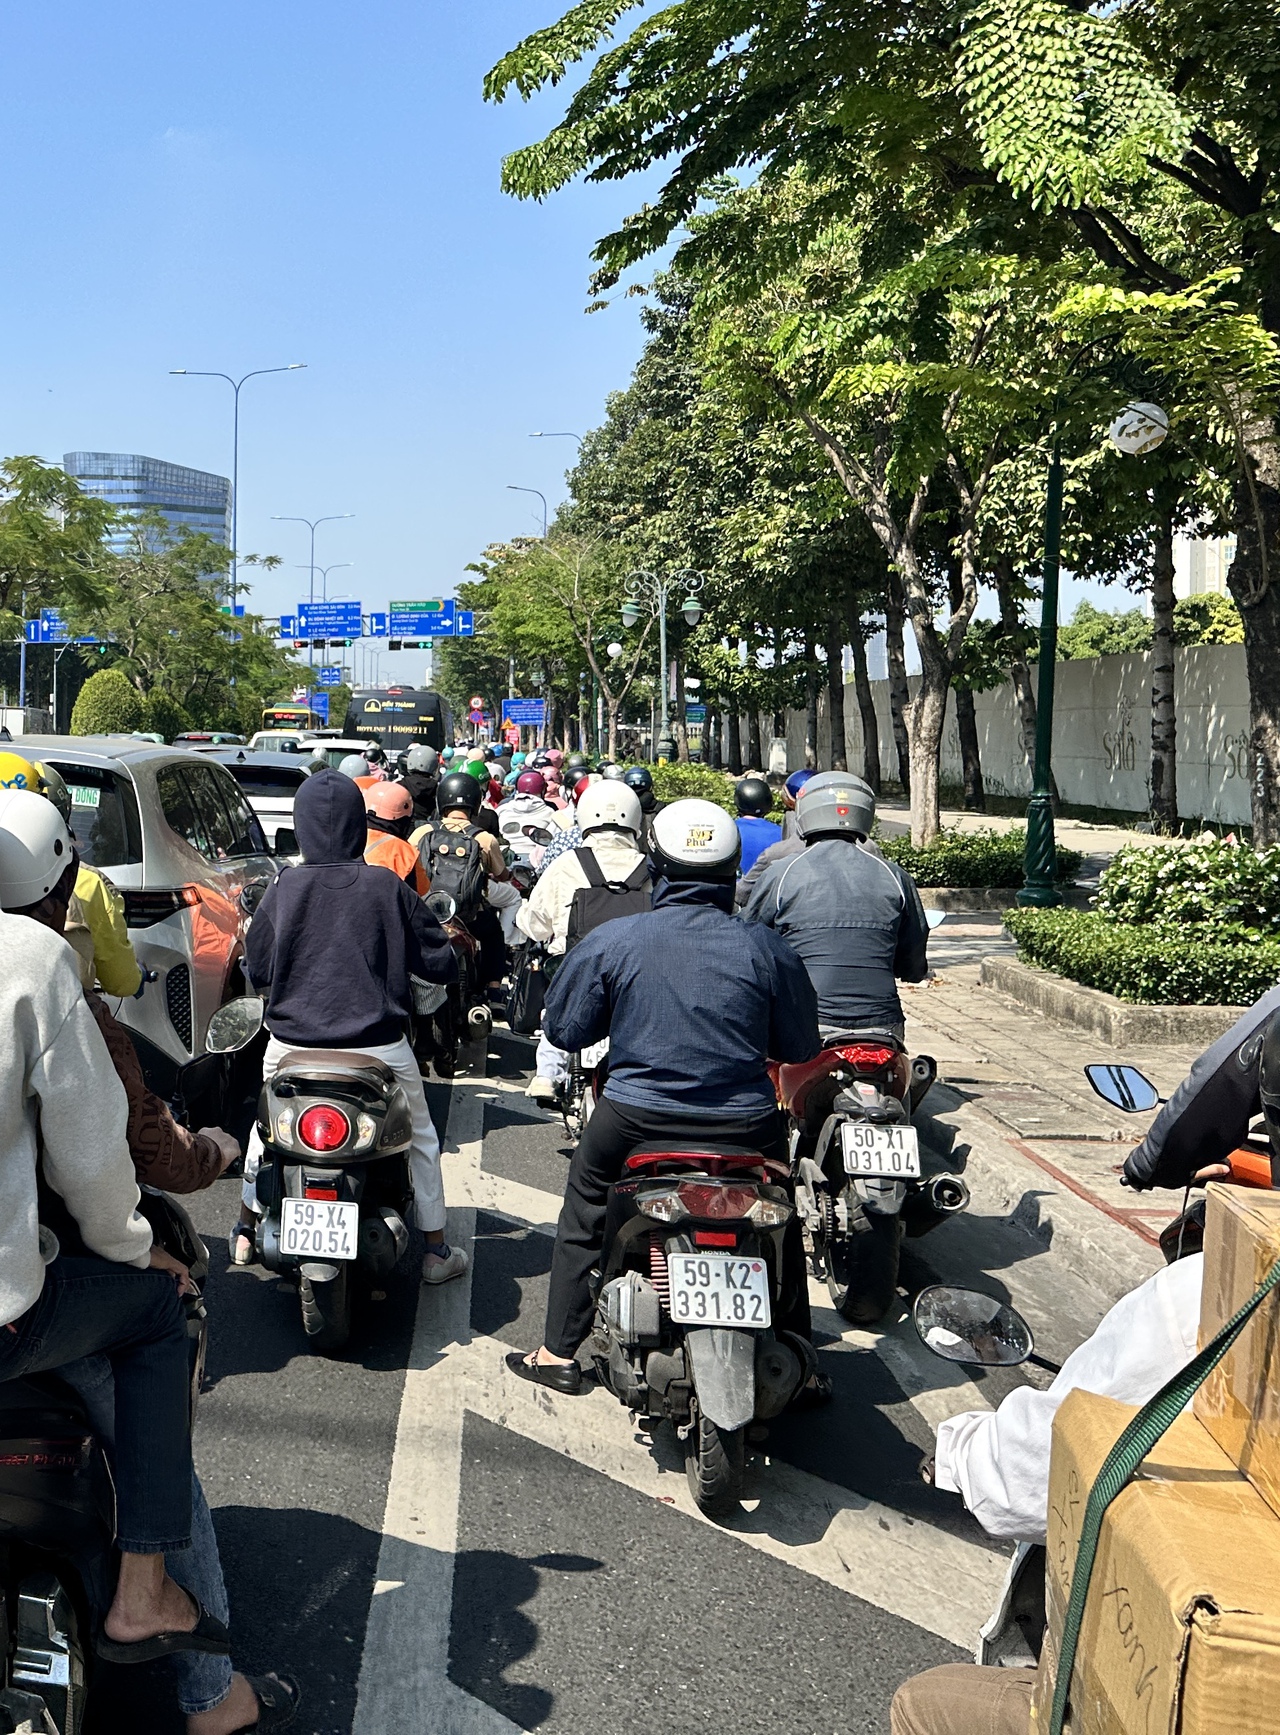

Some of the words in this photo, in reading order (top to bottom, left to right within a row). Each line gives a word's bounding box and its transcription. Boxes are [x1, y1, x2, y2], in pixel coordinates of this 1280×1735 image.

[388, 725, 427, 734] 19009211
[854, 1128, 904, 1150] 50-X1
[850, 1150, 915, 1173] 031.04
[294, 1204, 346, 1229] 59-X4
[288, 1228, 350, 1254] 020.54
[684, 1260, 752, 1289] 59-K2
[677, 1290, 763, 1322] 331.82
